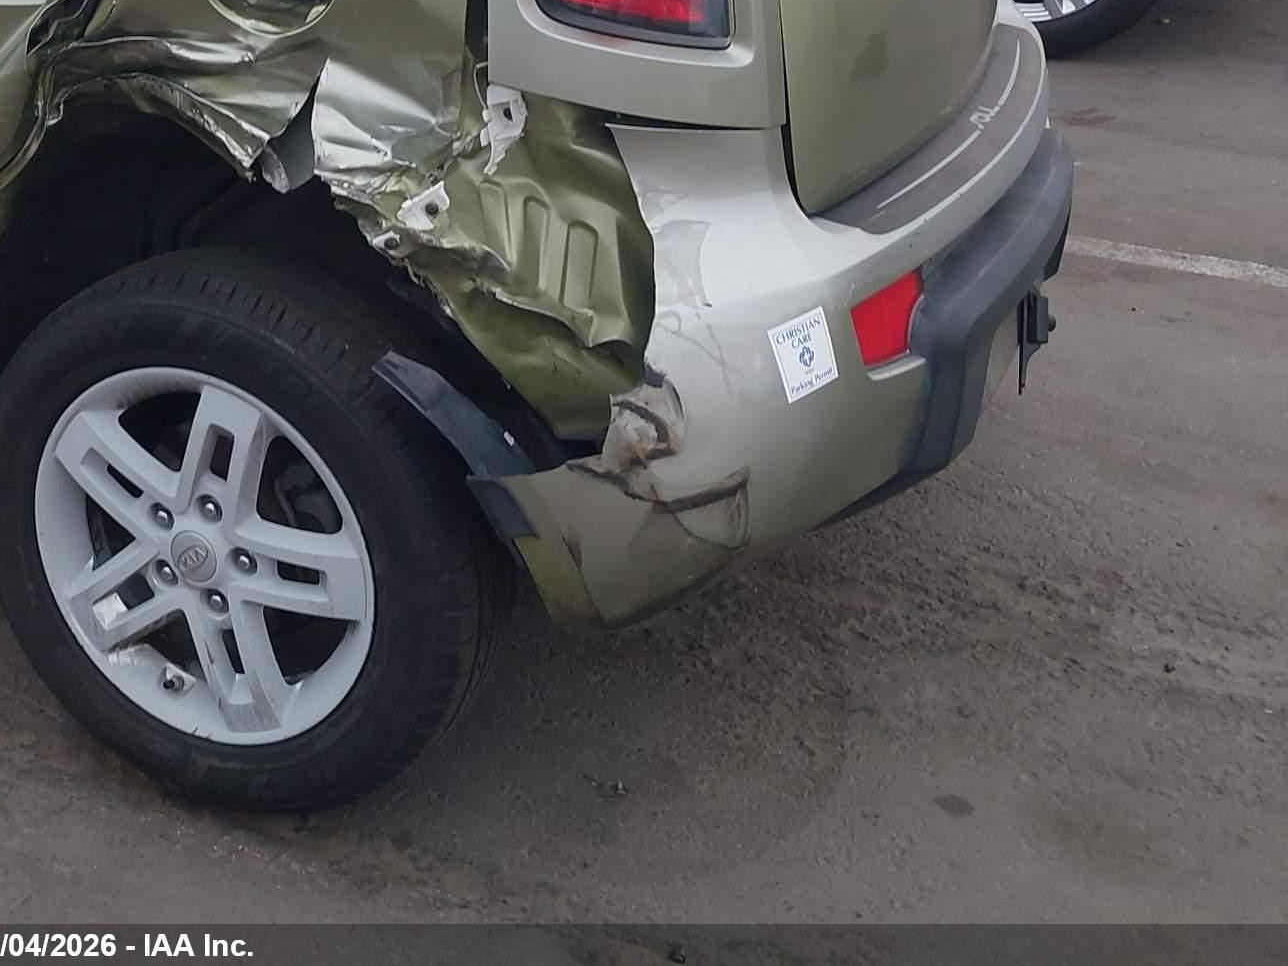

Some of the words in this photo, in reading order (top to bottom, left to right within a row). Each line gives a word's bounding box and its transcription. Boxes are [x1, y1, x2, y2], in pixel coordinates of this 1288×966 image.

[776, 315, 821, 345] CHRISTIAN
[791, 334, 813, 348] CARE
[790, 378, 814, 395] Parking
[814, 367, 833, 383] Permit
[181, 547, 206, 570] KIA
